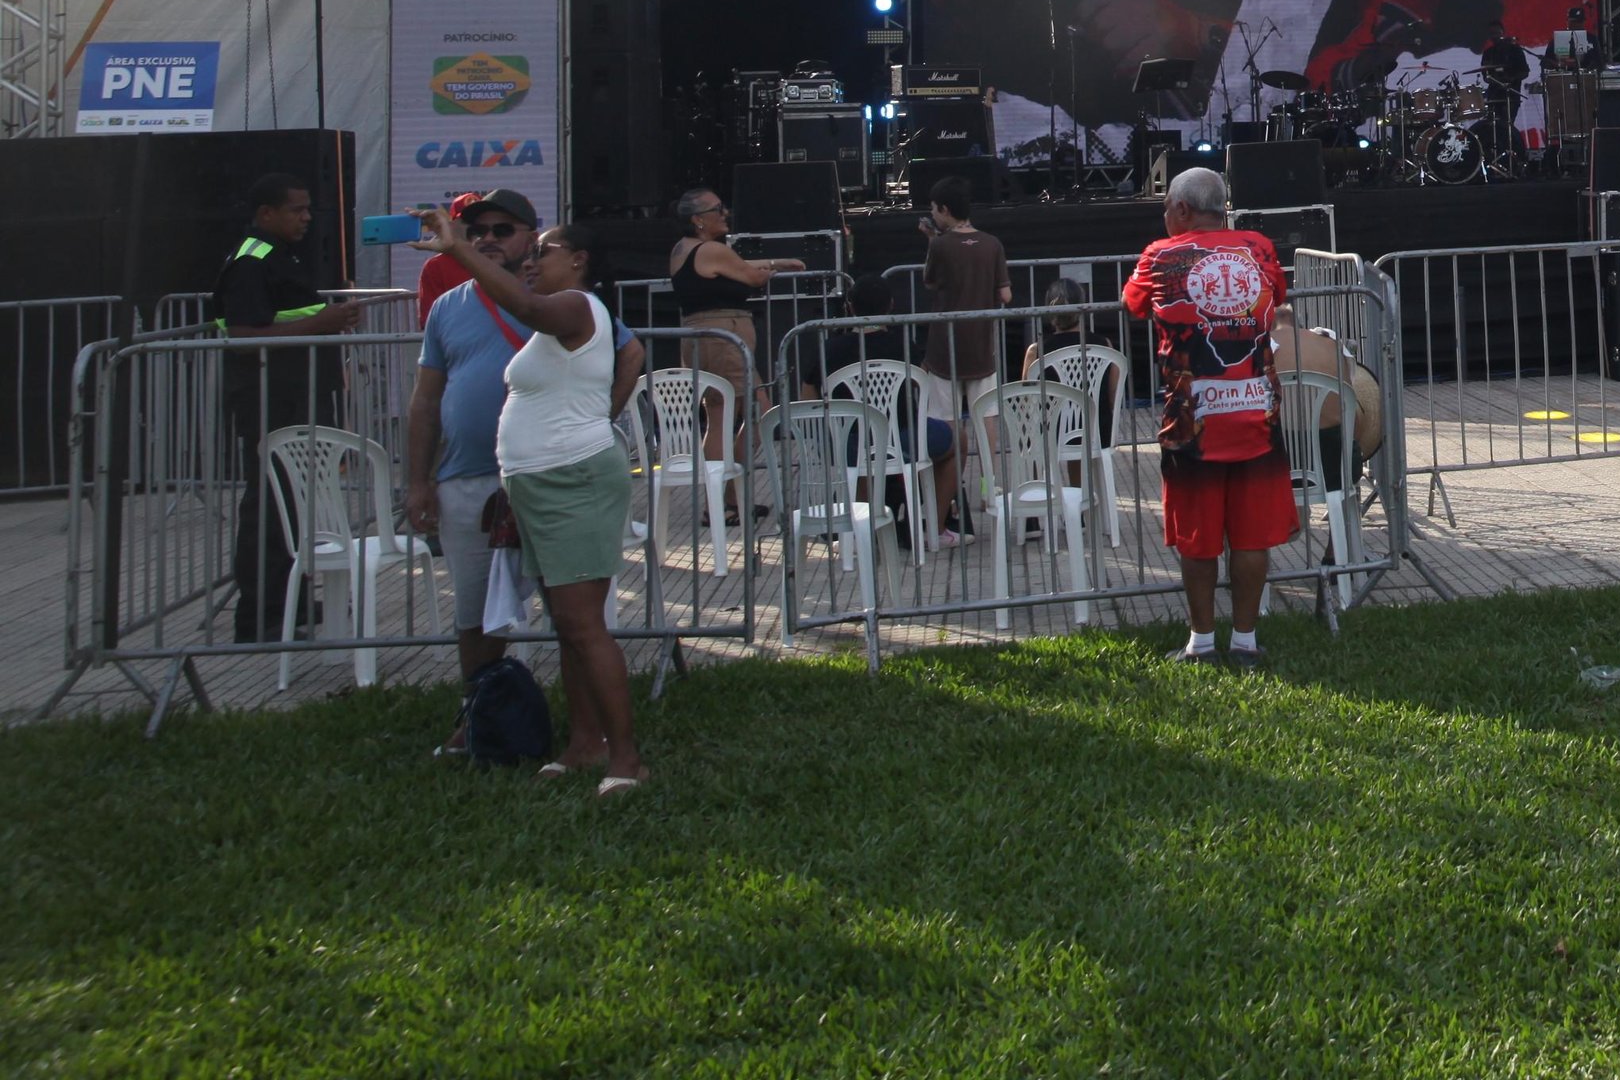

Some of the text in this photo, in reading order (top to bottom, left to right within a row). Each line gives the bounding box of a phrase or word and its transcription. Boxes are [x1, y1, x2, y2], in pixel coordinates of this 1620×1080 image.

[443, 31, 518, 43] PATROCÍNIO:
[106, 56, 196, 66] ÁREA EXCLUSIVA
[101, 66, 196, 99] PNE
[928, 71, 960, 82] Marshall
[446, 82, 515, 91] TEM GOVERNO
[455, 91, 505, 100] DO BRASIL
[937, 130, 968, 140] Marshall
[415, 139, 545, 170] CAIXA
[1192, 253, 1255, 275] IMPERADORES
[1203, 300, 1252, 315] DO SAMBA
[1197, 317, 1257, 330] Carnaval 2026
[1205, 381, 1265, 403] Orin Alá
